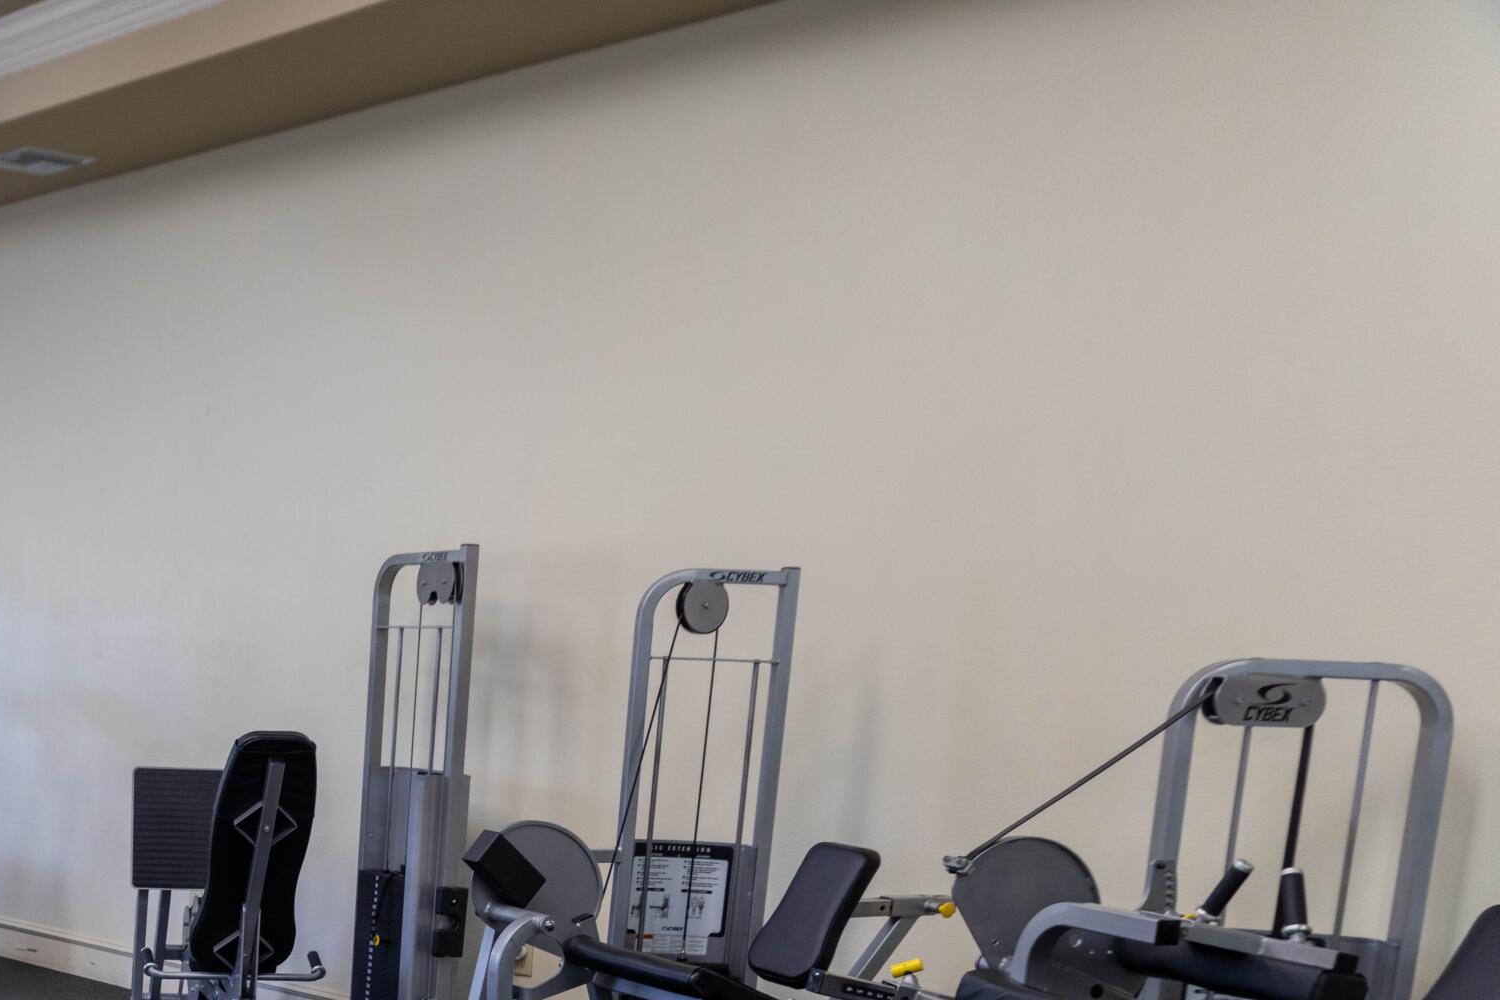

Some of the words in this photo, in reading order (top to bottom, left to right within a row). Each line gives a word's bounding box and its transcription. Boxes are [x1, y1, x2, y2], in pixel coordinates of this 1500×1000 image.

[726, 571, 767, 583] CYBEX
[1242, 705, 1295, 723] CYBEX
[667, 845, 711, 853] EXTENION
